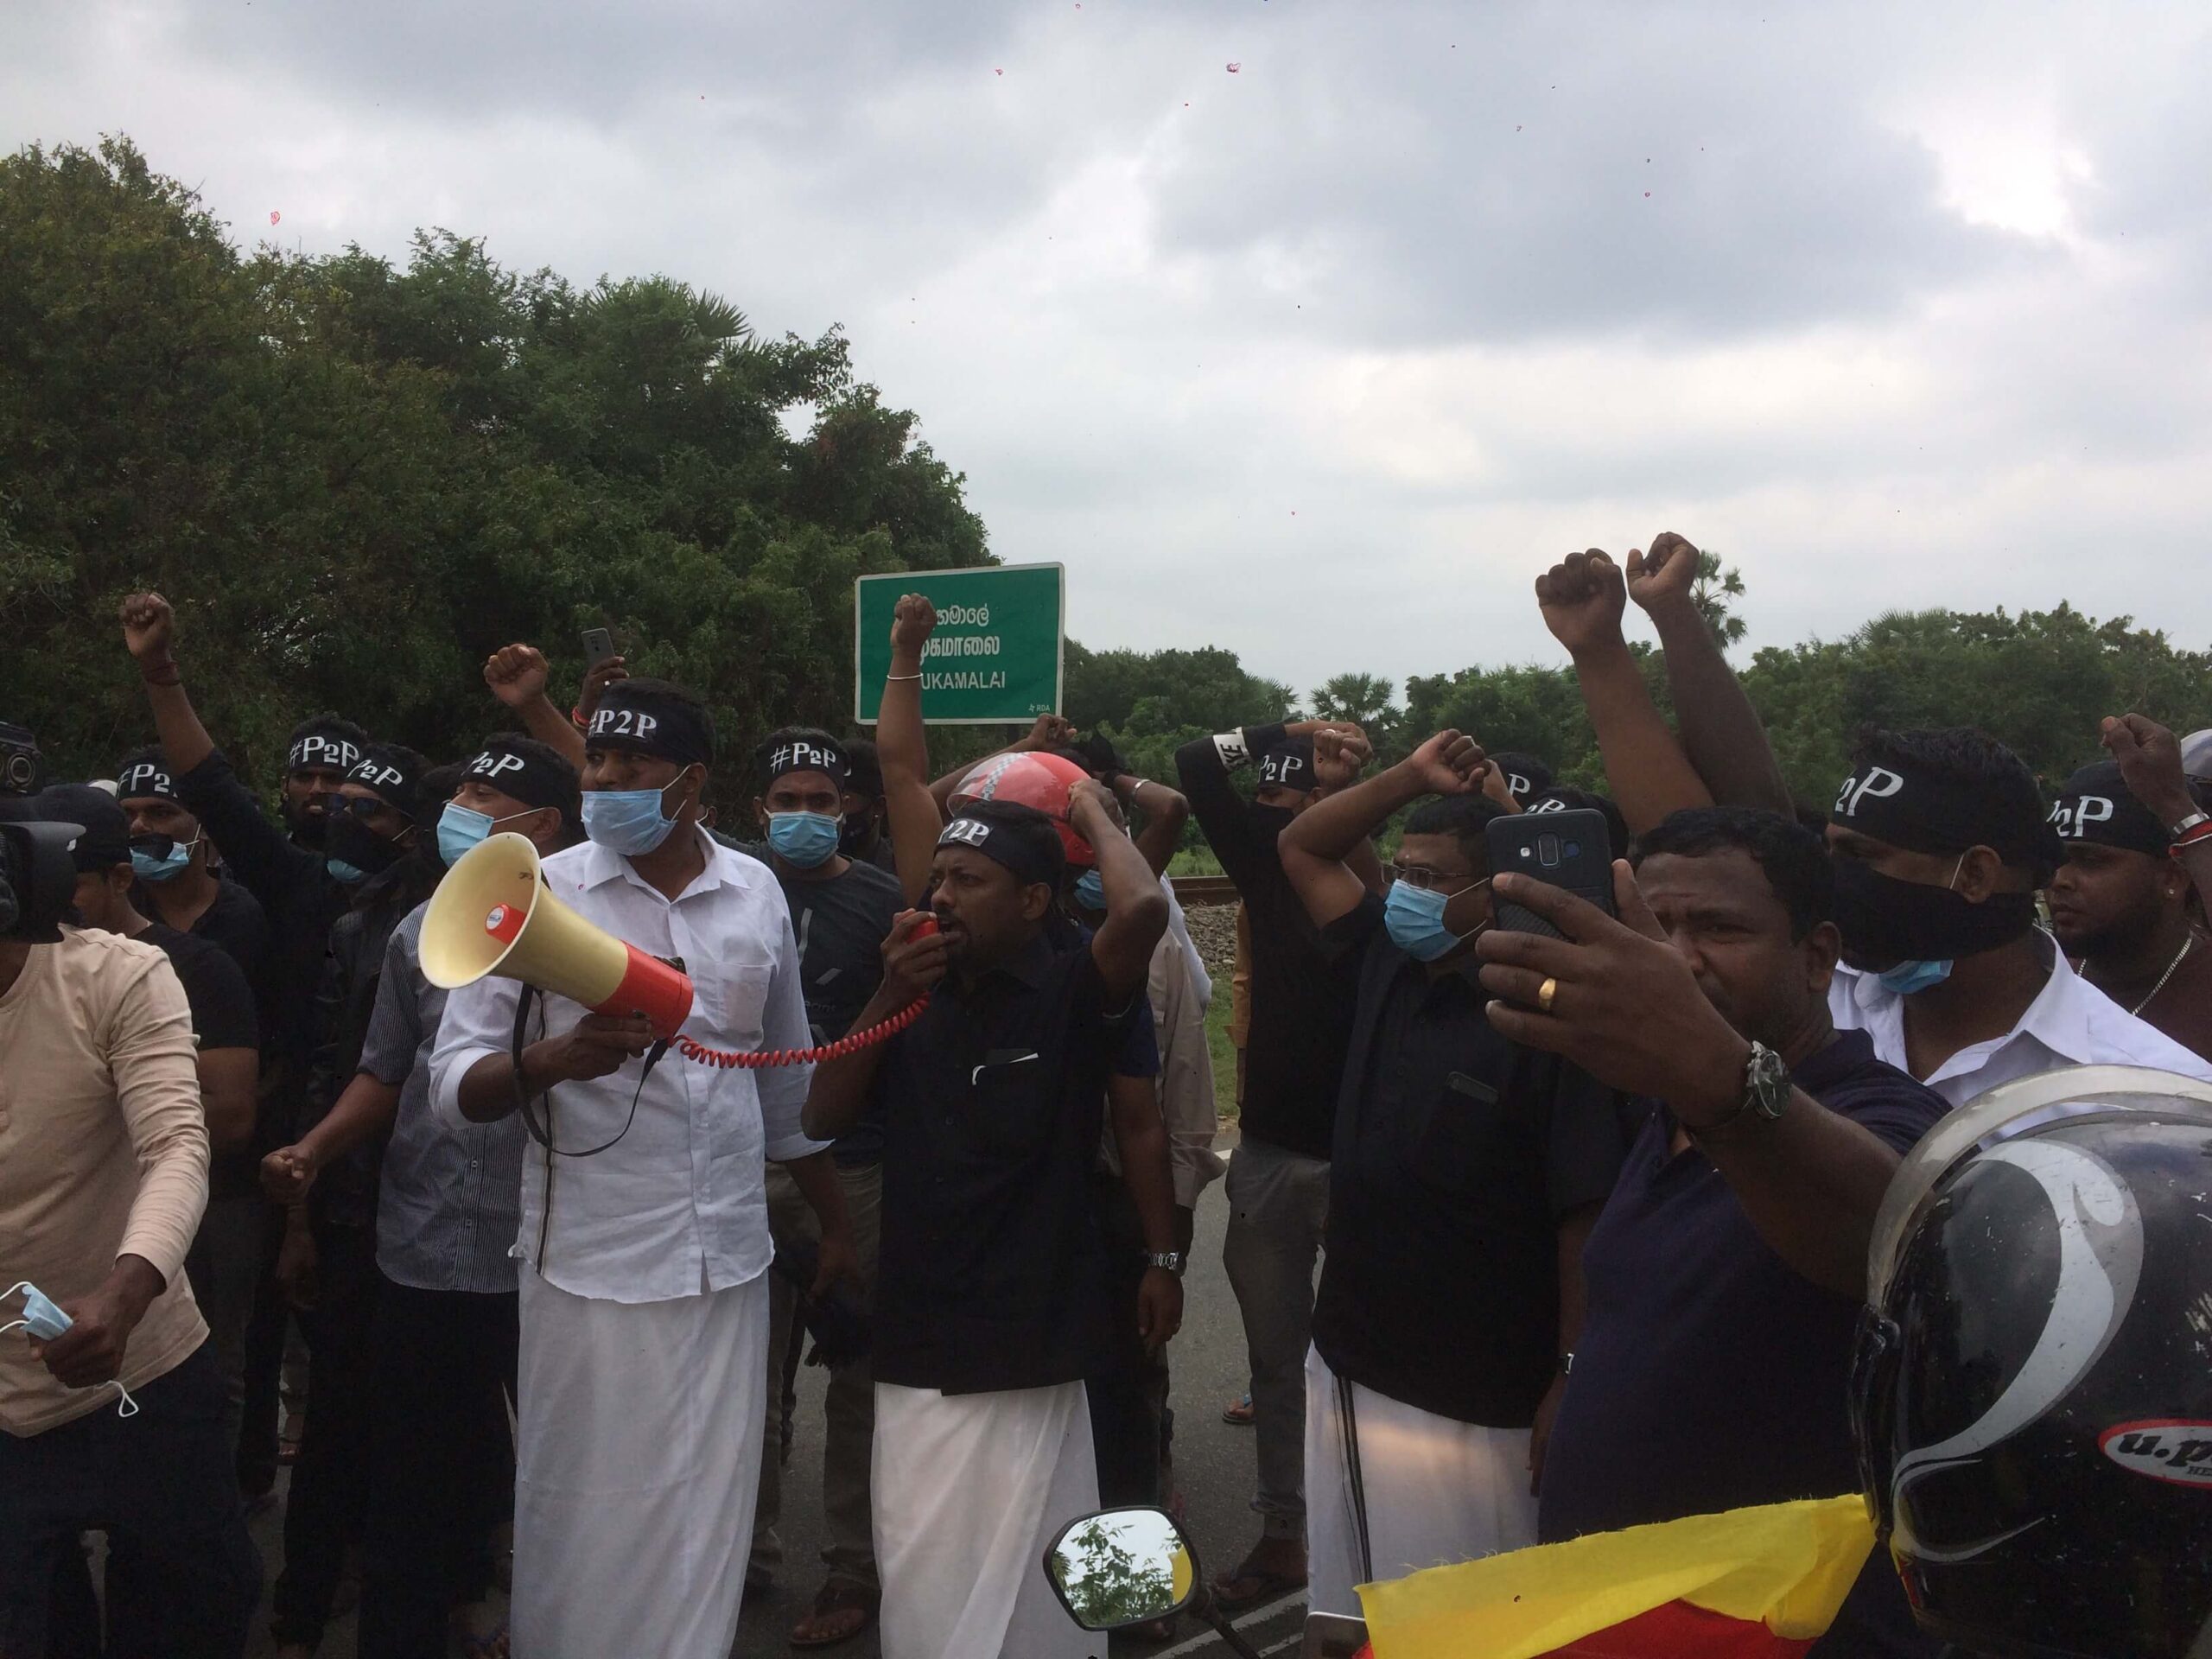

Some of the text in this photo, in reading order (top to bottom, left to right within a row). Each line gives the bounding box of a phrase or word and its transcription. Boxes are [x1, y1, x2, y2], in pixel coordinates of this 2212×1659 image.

[1036, 704, 1051, 713] RDA
[289, 735, 359, 768] #P2P
[770, 742, 836, 774] #P2P
[116, 764, 178, 798] #P2
